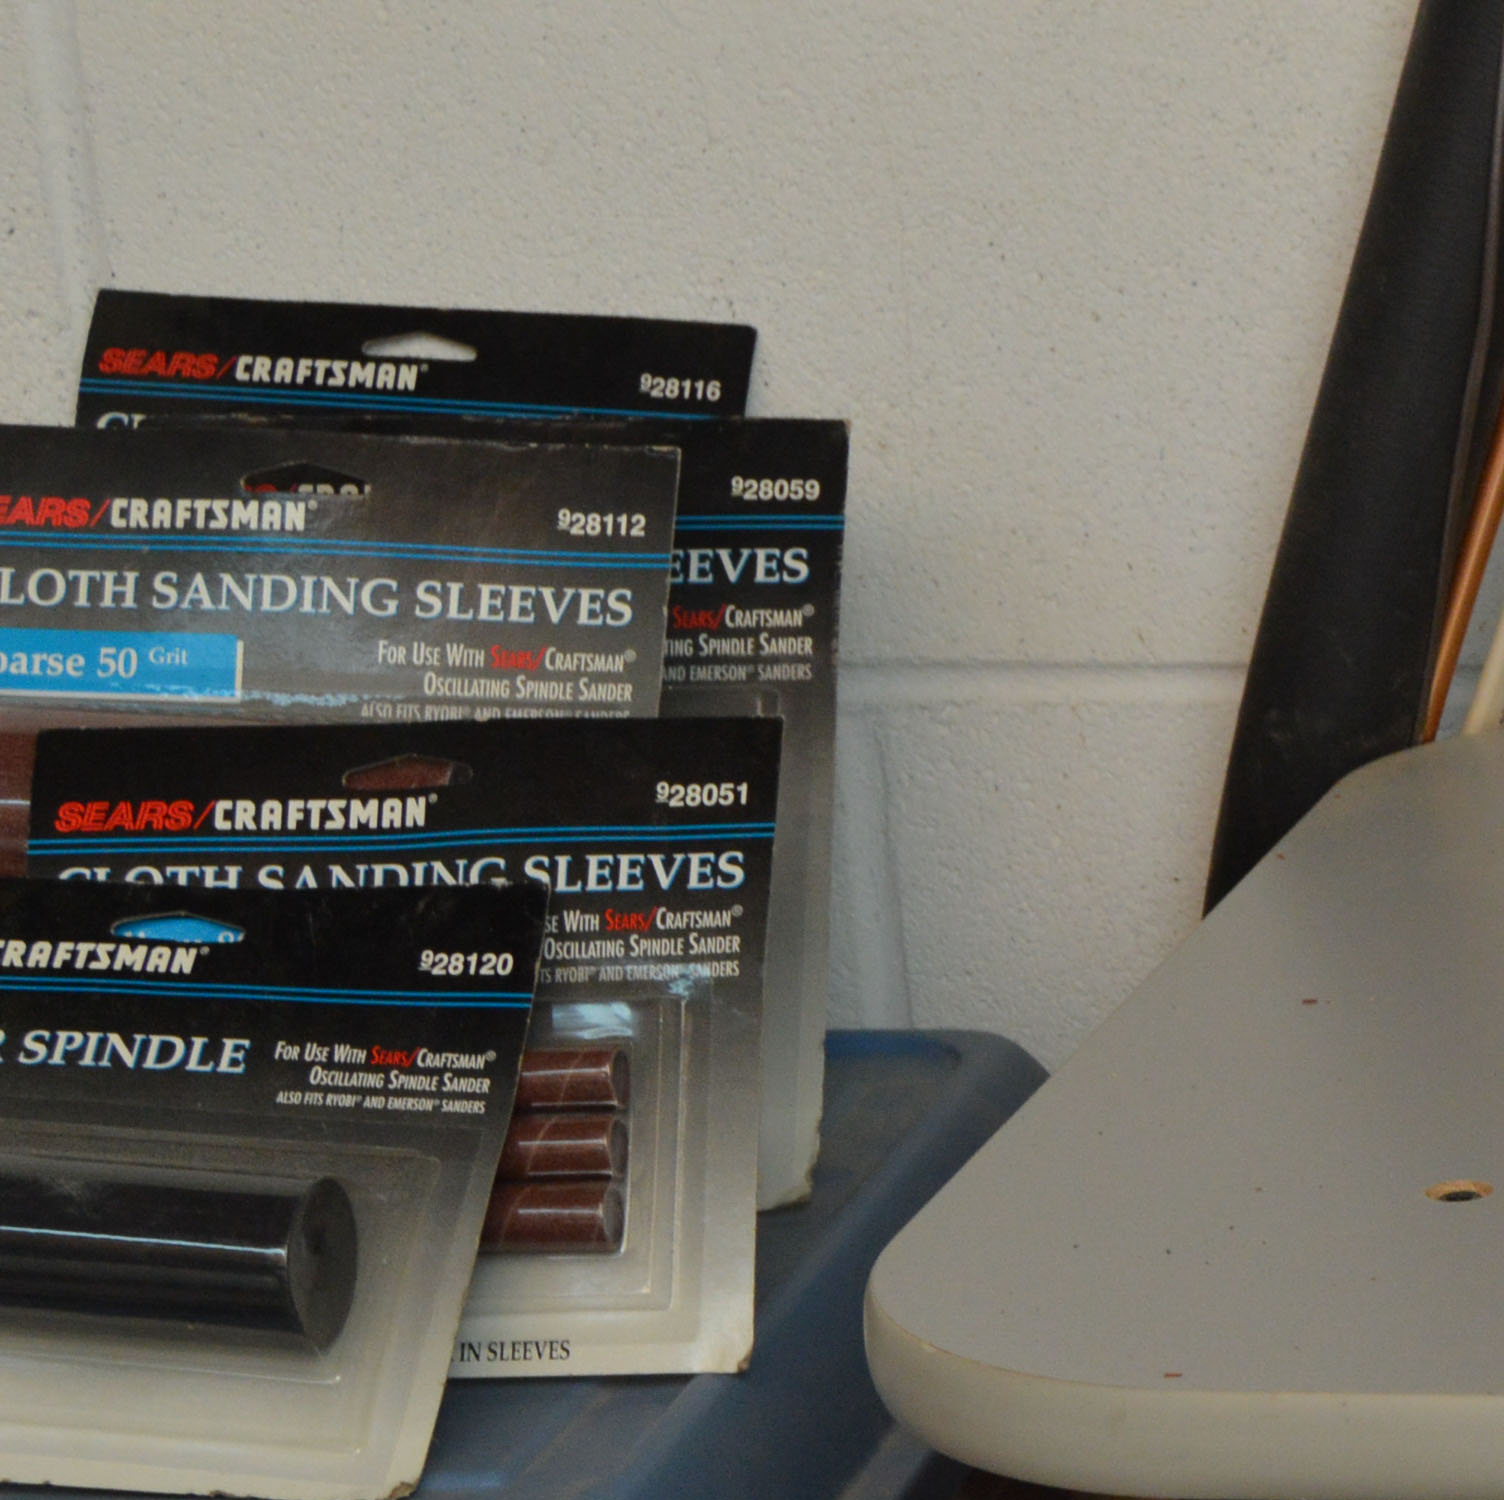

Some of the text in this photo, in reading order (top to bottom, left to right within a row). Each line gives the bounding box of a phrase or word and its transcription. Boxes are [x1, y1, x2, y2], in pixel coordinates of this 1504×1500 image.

[639, 372, 721, 402] 928116
[730, 475, 821, 501] 928059
[0, 494, 306, 531] EARS/CRAFTSMAN
[557, 508, 646, 537] 928112
[668, 547, 809, 584] EEVES
[0, 567, 633, 628] LOTH SANDING SLEEVES
[97, 645, 189, 679] 50 Grit
[656, 781, 749, 807] 928051
[524, 851, 746, 893] SLEEVES
[0, 939, 198, 975] RAFTSMAN
[418, 950, 514, 976] 928120
[18, 1029, 250, 1075] SPINDLE
[459, 1340, 571, 1362] IN SLEEVES
